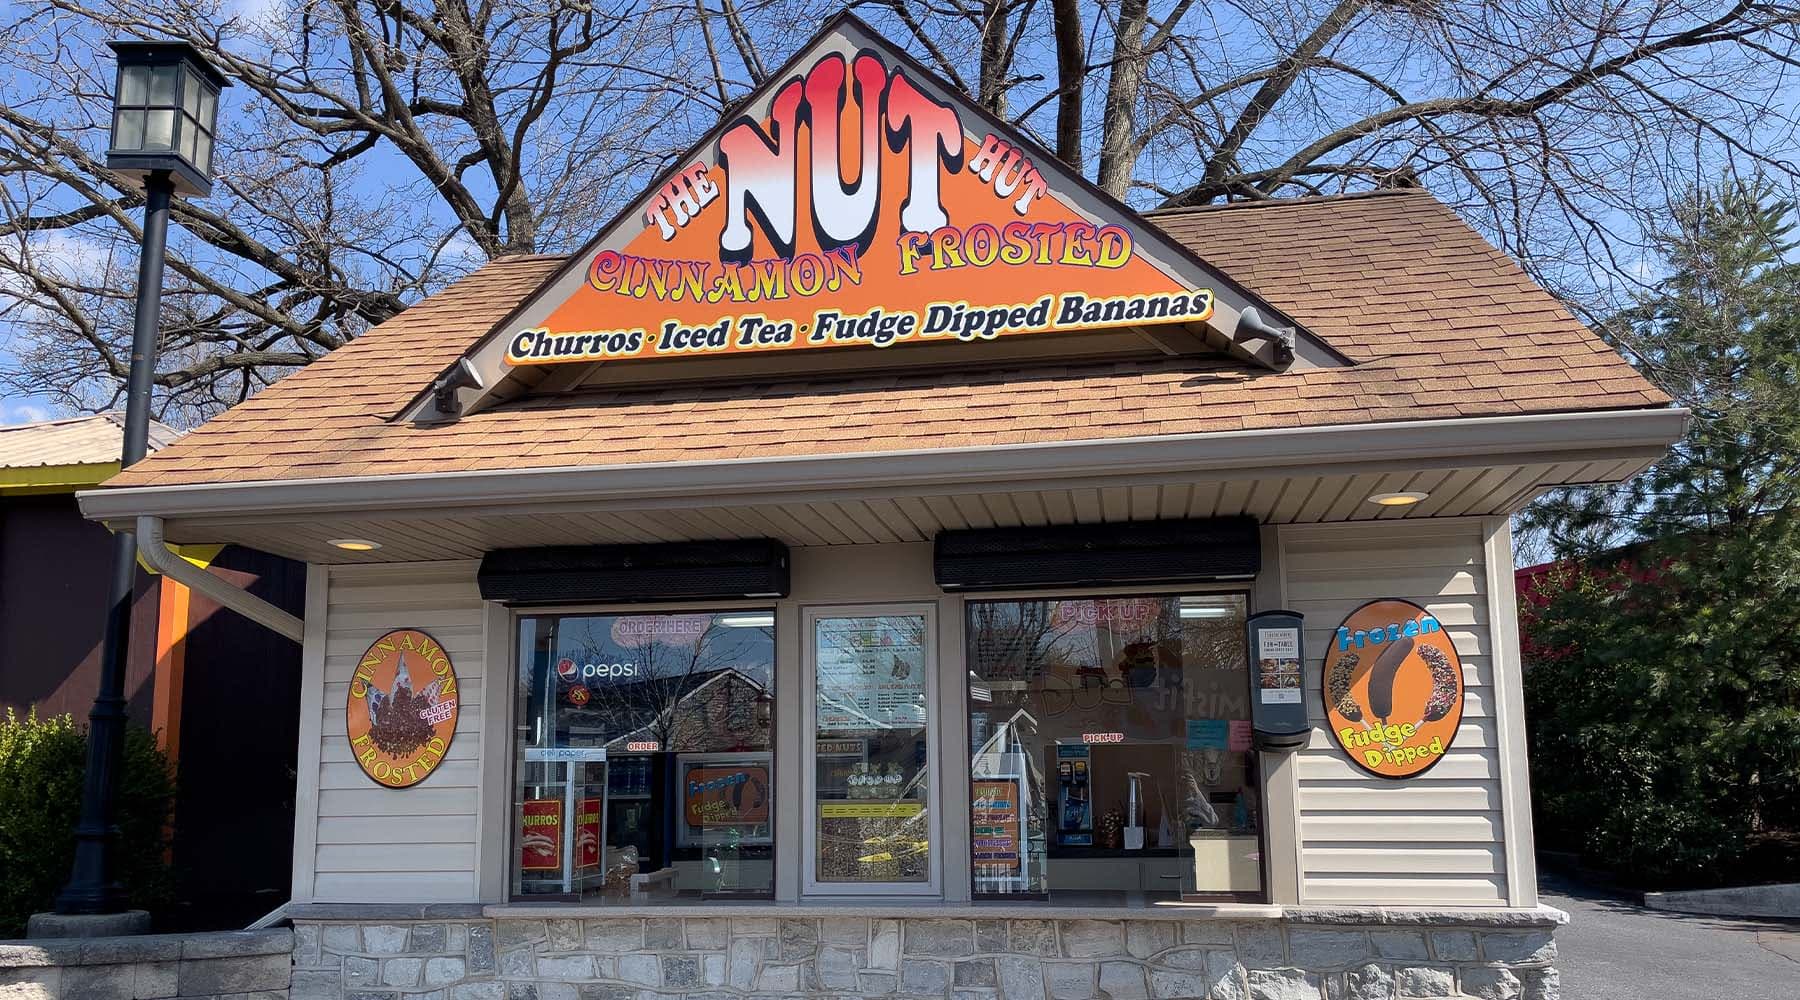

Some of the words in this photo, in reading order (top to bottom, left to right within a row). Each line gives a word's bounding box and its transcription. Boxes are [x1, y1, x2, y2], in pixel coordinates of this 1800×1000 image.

[644, 161, 720, 241] THE
[714, 48, 964, 265] NUT
[968, 133, 1047, 216] HUT
[588, 243, 862, 303] CINNAMON
[897, 222, 1134, 275] FROSTED
[511, 332, 642, 358] Churros
[659, 320, 731, 350] Iced
[738, 318, 793, 345] Tea
[811, 312, 915, 343] Fudge
[923, 299, 1050, 338] Dipped
[1056, 292, 1209, 325] Bananas
[351, 633, 457, 699] CINNAMON
[582, 659, 639, 680] pepsi
[420, 700, 456, 719] GLUTEN
[428, 711, 452, 725] FREE
[628, 742, 658, 751] ORDER
[1340, 721, 1417, 749] Fudge
[352, 734, 446, 785] FROSTED
[1365, 737, 1444, 768] Dipped
